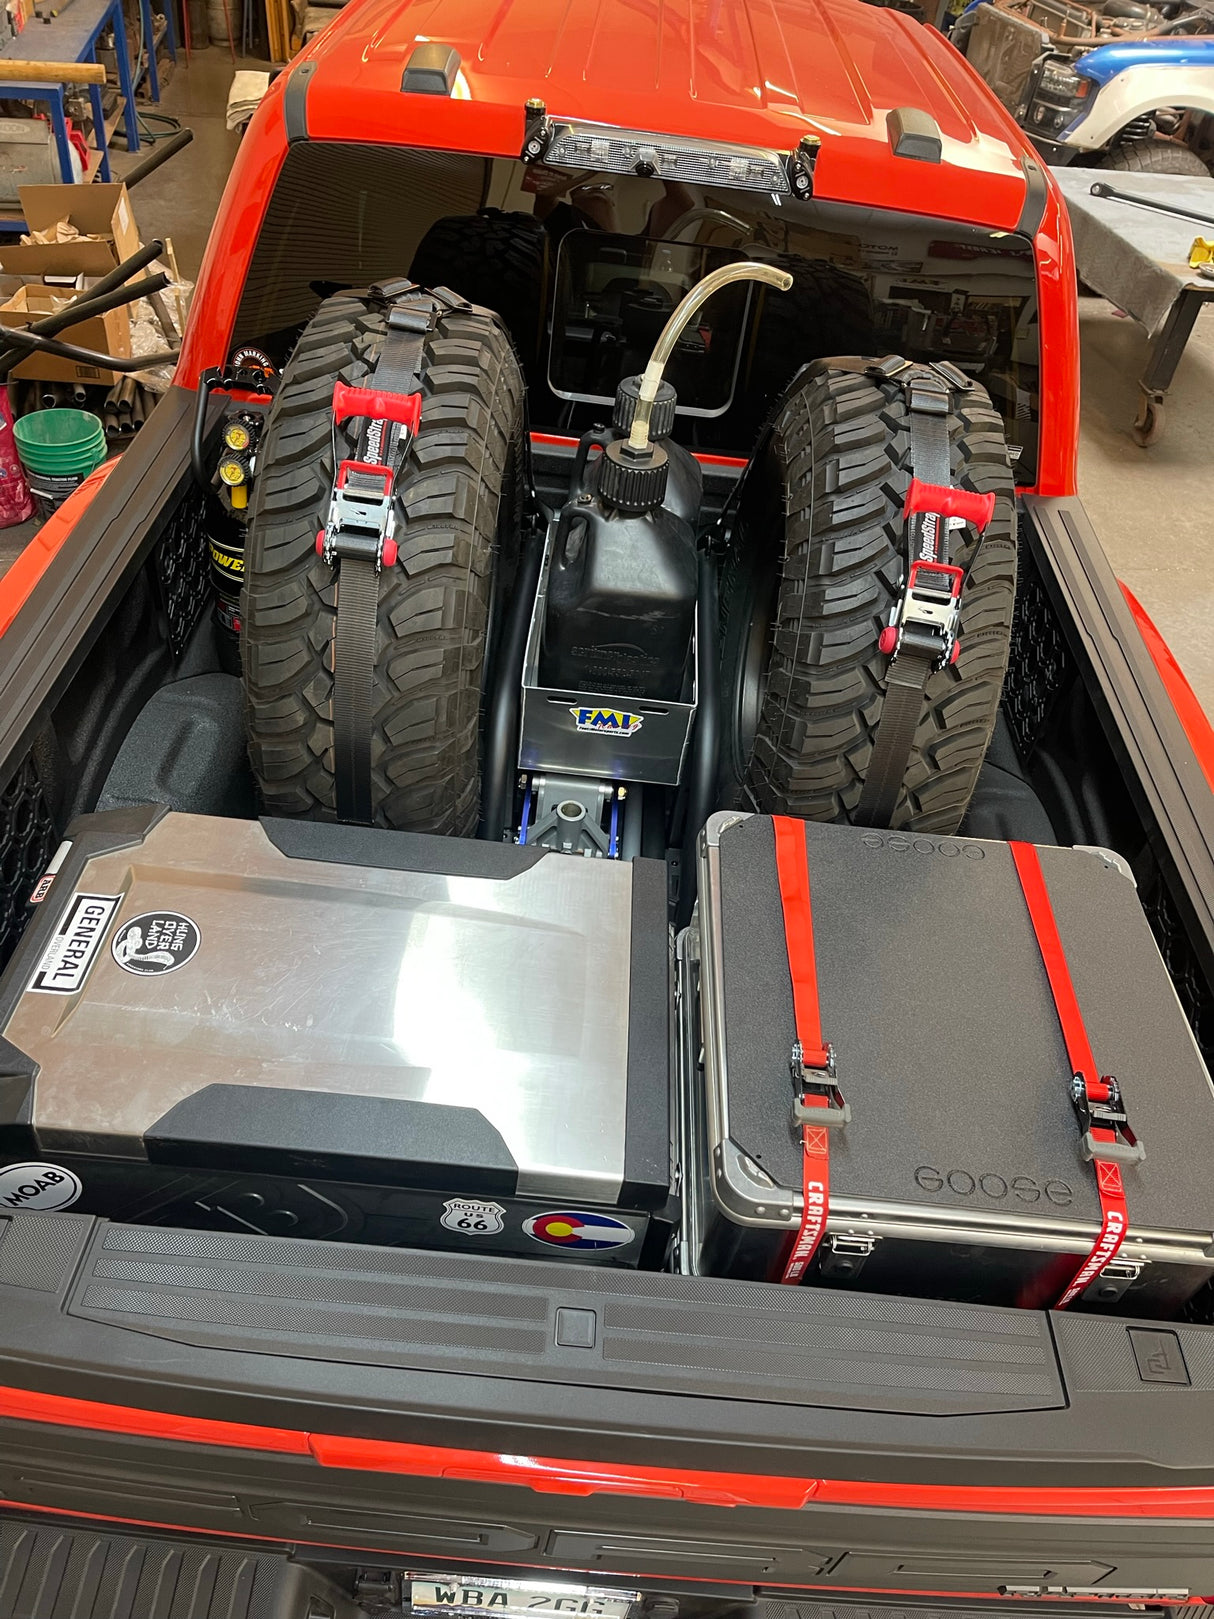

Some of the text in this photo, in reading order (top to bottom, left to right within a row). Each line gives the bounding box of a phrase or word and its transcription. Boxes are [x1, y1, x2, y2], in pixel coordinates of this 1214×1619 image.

[363, 418, 388, 465] SpeedStra
[208, 541, 246, 573] POWE
[578, 709, 631, 730] FMI
[35, 879, 52, 899] ARB
[52, 905, 106, 981] GENERAL
[145, 920, 165, 949] LAND
[157, 920, 177, 950] OVER
[171, 922, 190, 951] HUNG
[42, 936, 65, 970] OVERLAND
[3, 1171, 65, 1206] MOAB
[453, 1203, 496, 1213] ROUTE
[795, 1181, 824, 1258] CRAFTSMAN
[457, 1217, 488, 1231] 66
[1075, 1210, 1124, 1285] CRAFTSMAN
[434, 1586, 508, 1608] WBA
